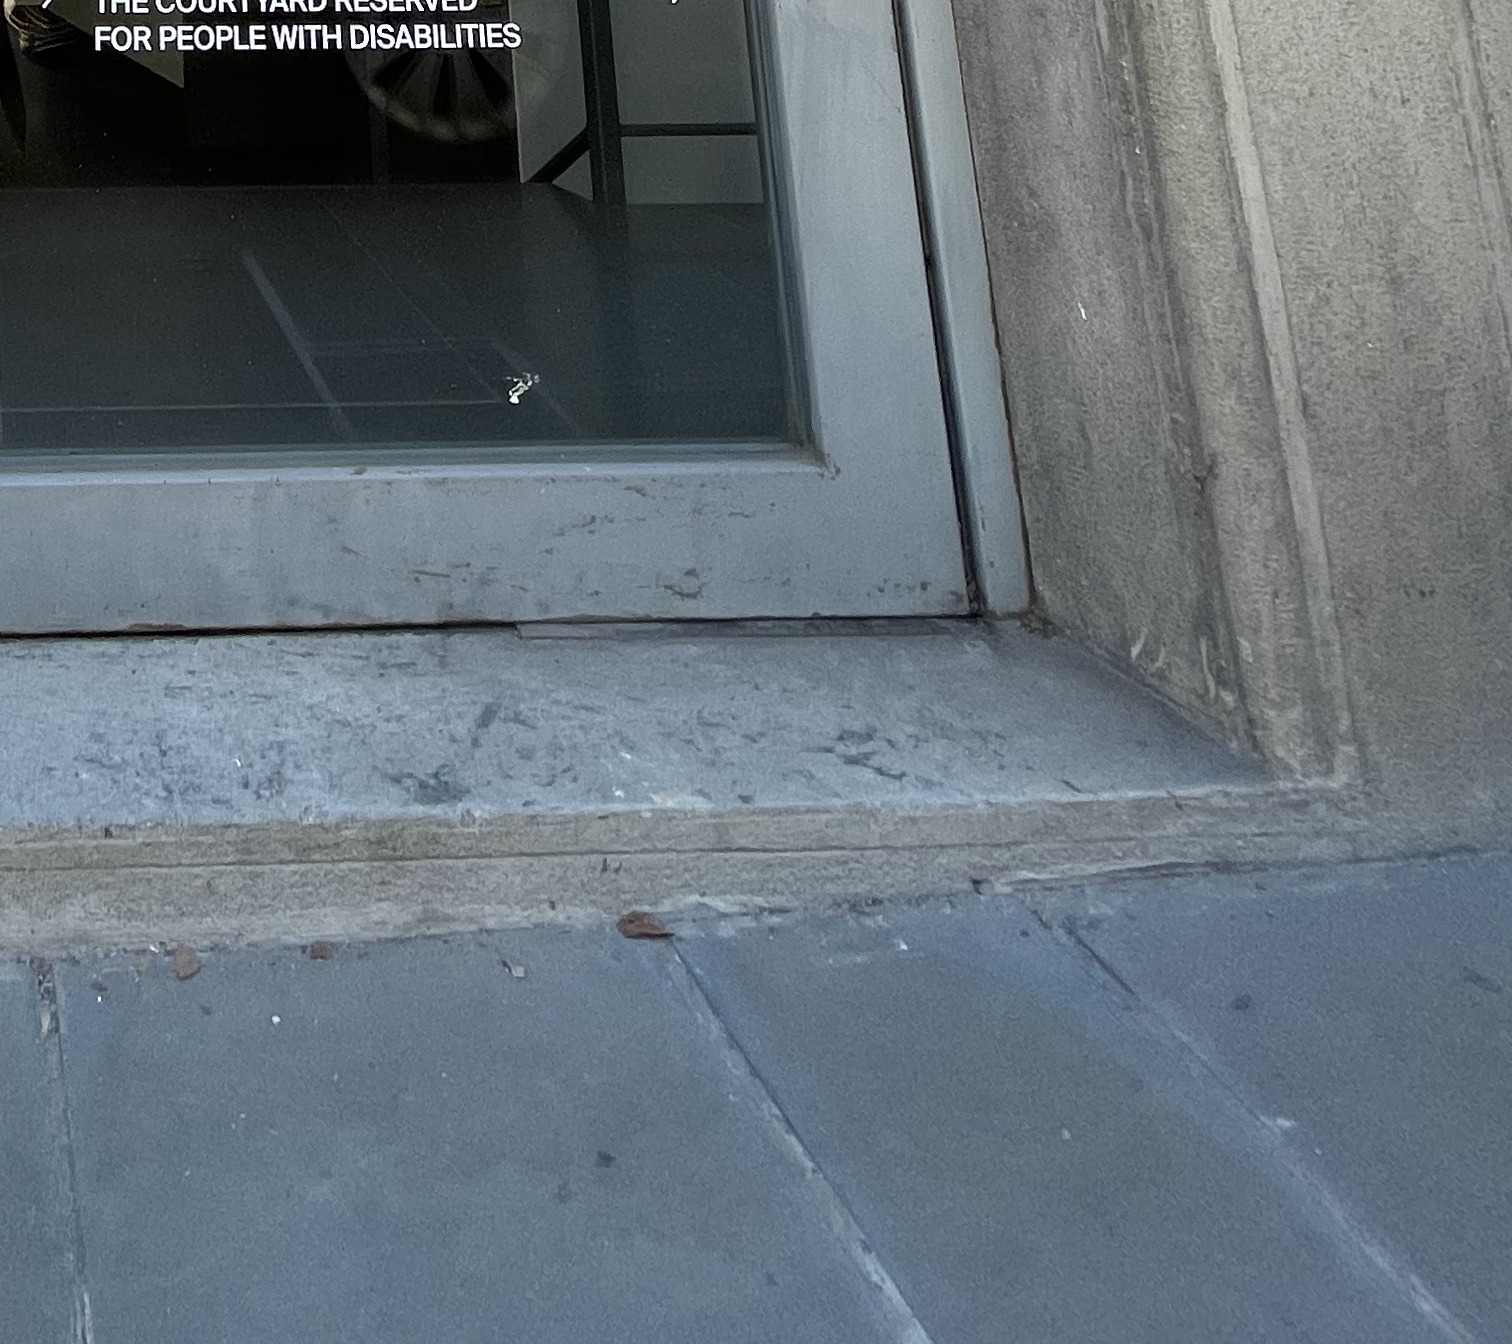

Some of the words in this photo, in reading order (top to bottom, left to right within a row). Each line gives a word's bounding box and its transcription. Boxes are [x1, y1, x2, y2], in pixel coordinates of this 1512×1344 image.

[94, 25, 151, 52] FOR
[158, 24, 266, 51] PEOPLE
[272, 24, 343, 50] WITH
[350, 23, 522, 50] DISABILITIES
